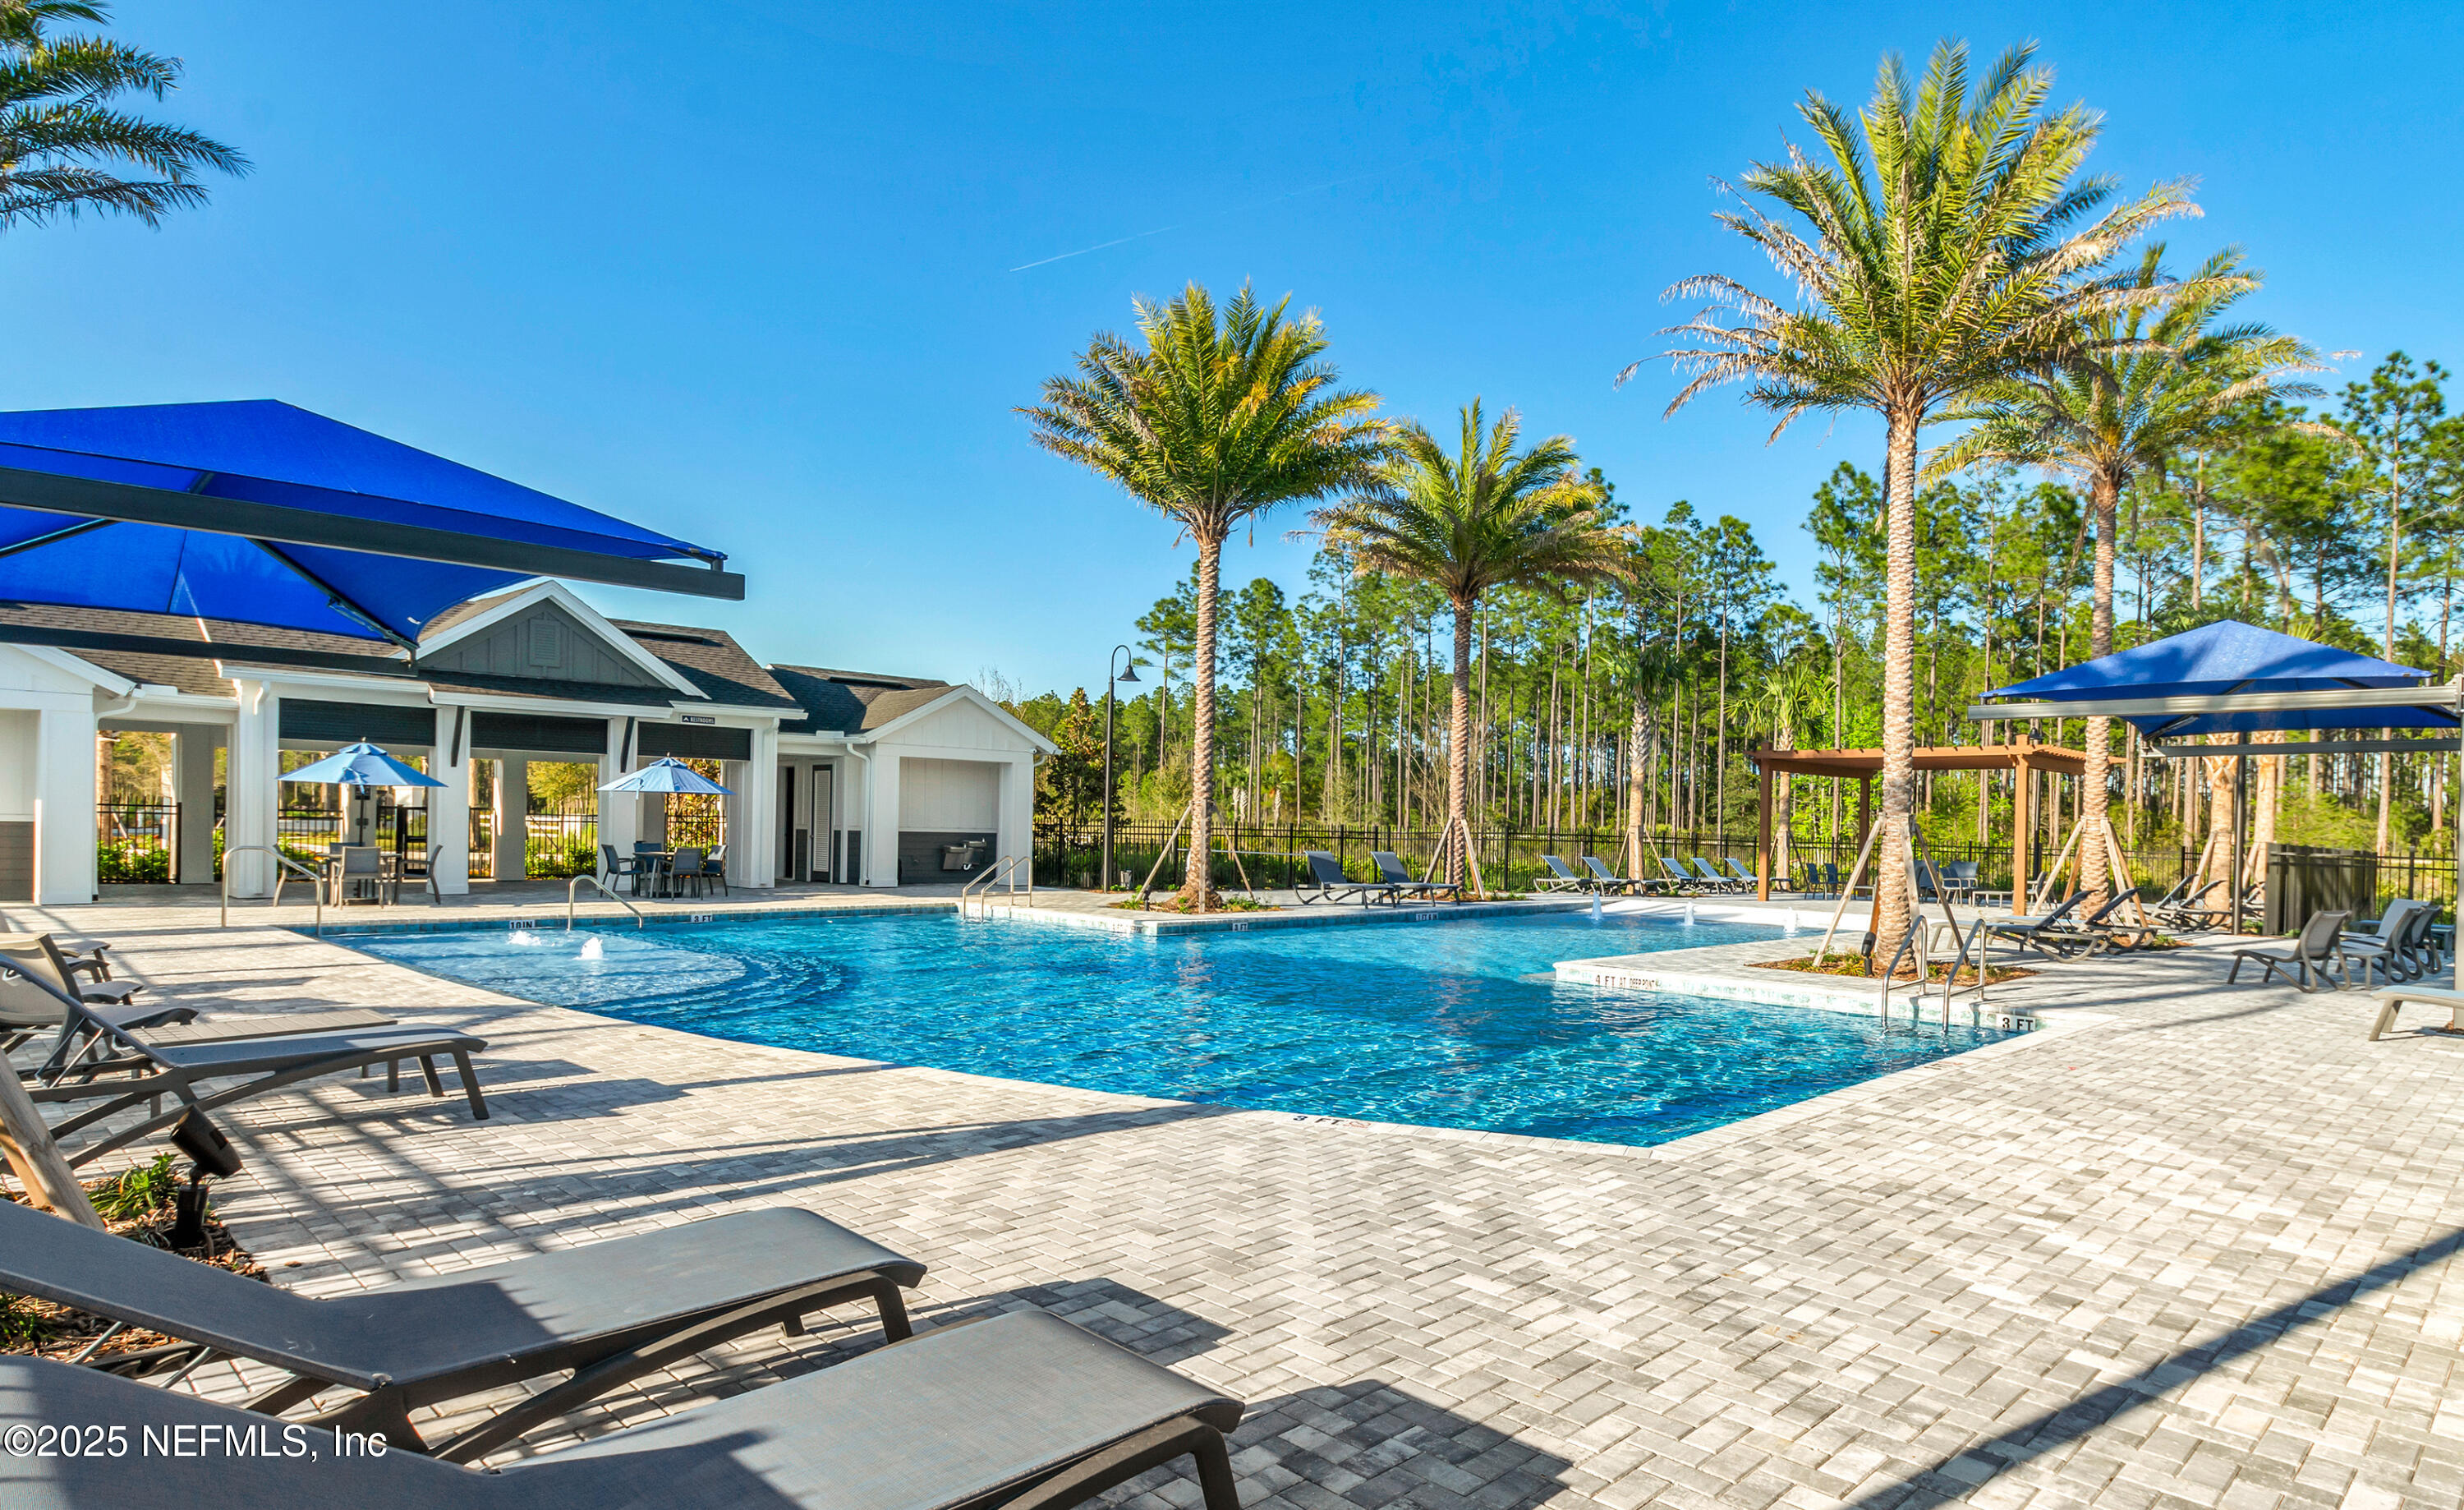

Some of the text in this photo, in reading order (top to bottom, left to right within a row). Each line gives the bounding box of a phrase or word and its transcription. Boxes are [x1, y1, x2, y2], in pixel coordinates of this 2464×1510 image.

[690, 716, 715, 724] RESTROOMS
[1595, 974, 1601, 986] 4
[1605, 975, 1616, 987] FT
[1619, 977, 1626, 988] AT
[2002, 1017, 2034, 1031] 3 FT
